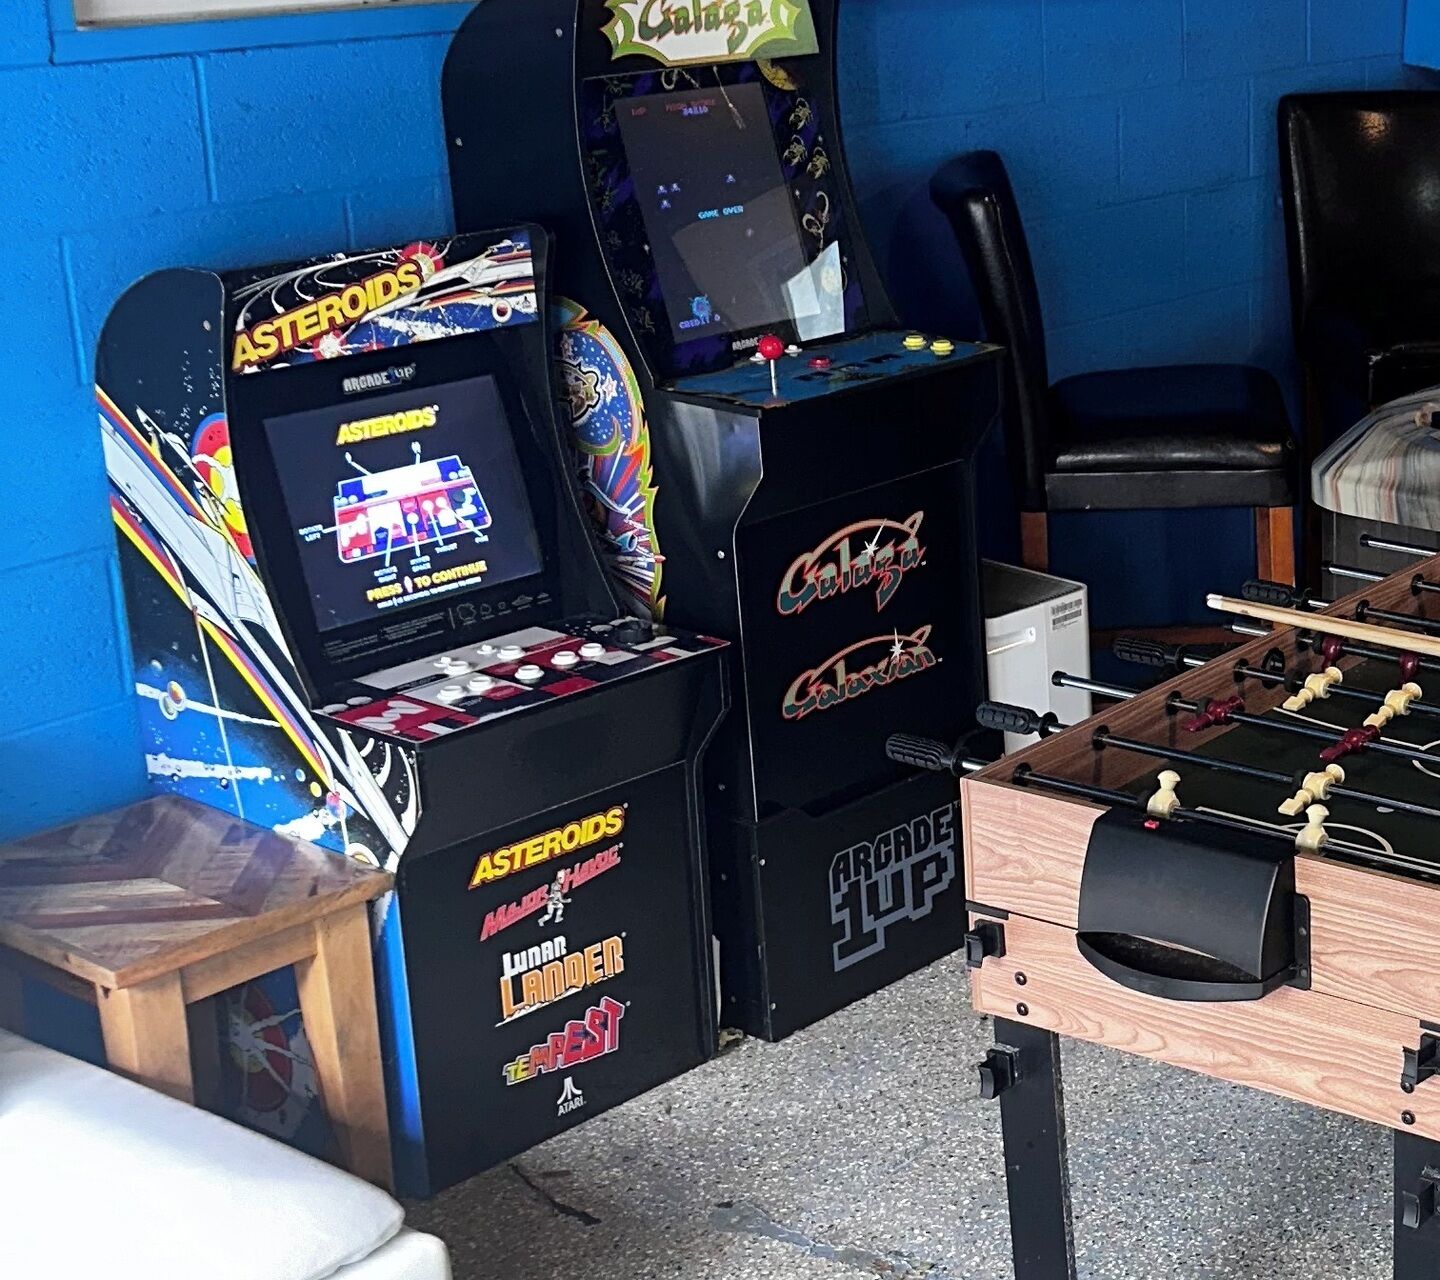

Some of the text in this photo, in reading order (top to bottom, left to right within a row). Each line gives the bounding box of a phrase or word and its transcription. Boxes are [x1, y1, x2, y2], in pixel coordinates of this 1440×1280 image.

[698, 205, 744, 220] GAME OVER
[232, 260, 423, 373] ASTEROIDS
[336, 407, 437, 446] ASTEROIDS
[366, 583, 403, 601] PRESS
[413, 575, 431, 589] TO
[431, 560, 488, 585] CONTINUE
[468, 806, 625, 890] ASTEROIDS
[829, 803, 955, 895] ARCADE
[500, 935, 625, 1020] LANDER
[502, 996, 625, 1086] TEMPEST
[557, 1095, 585, 1117] ATARI
